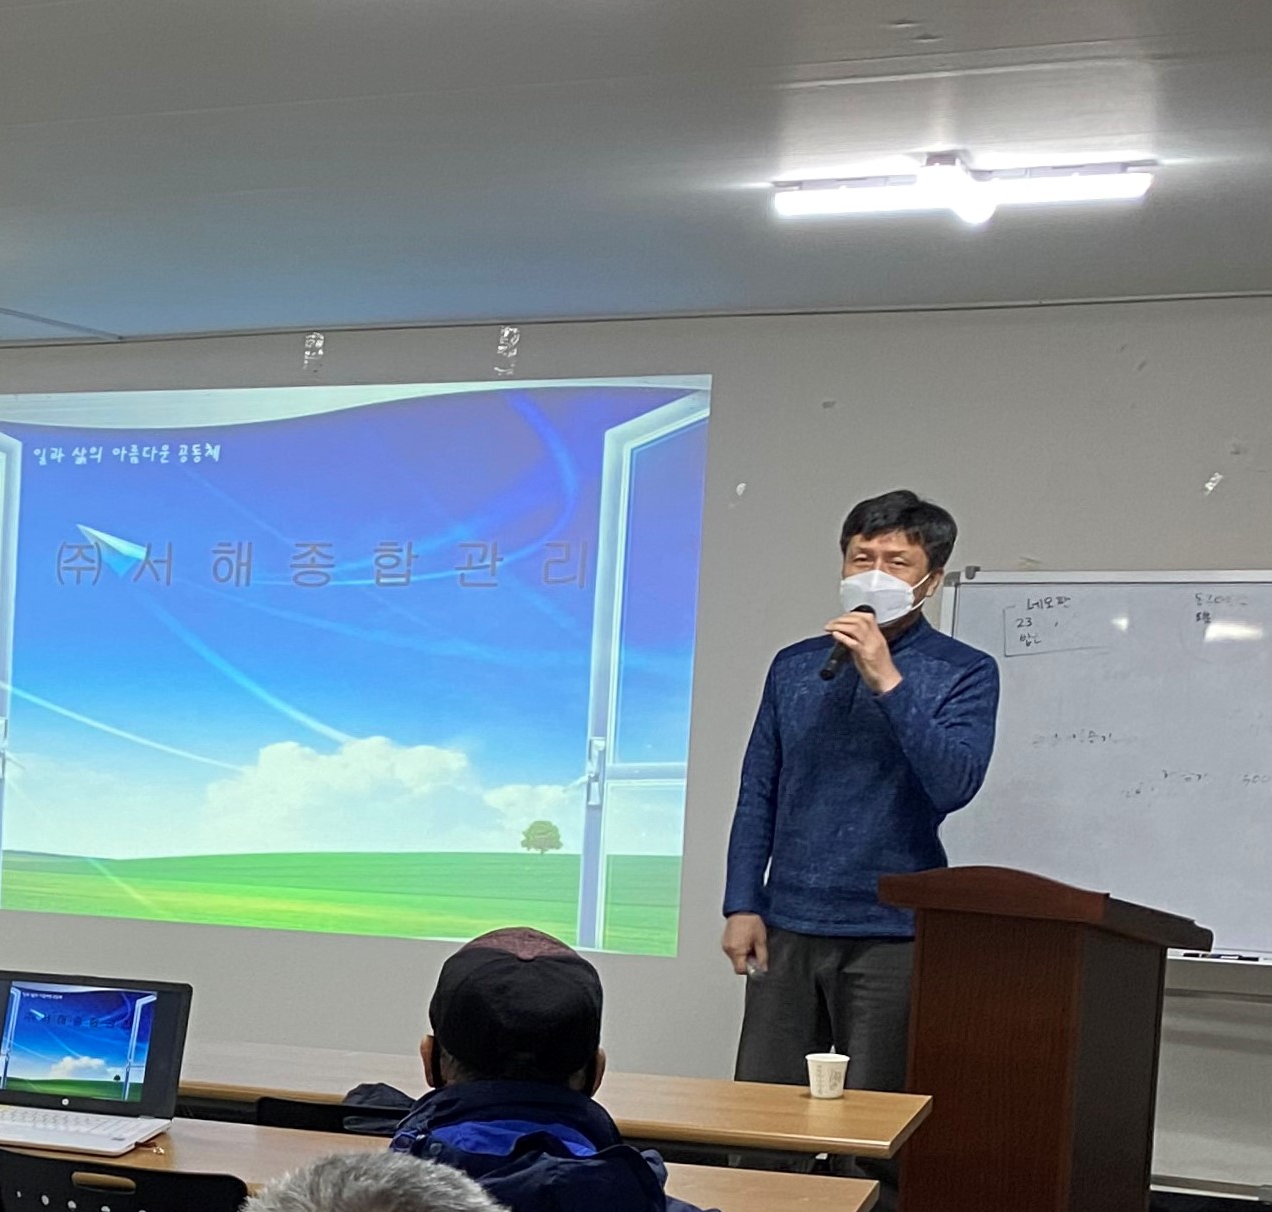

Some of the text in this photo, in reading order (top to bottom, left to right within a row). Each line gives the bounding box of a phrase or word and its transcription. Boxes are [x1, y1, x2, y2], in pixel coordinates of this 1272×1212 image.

[33, 442, 221, 466] 일과 삶의 아름다운 공동체
